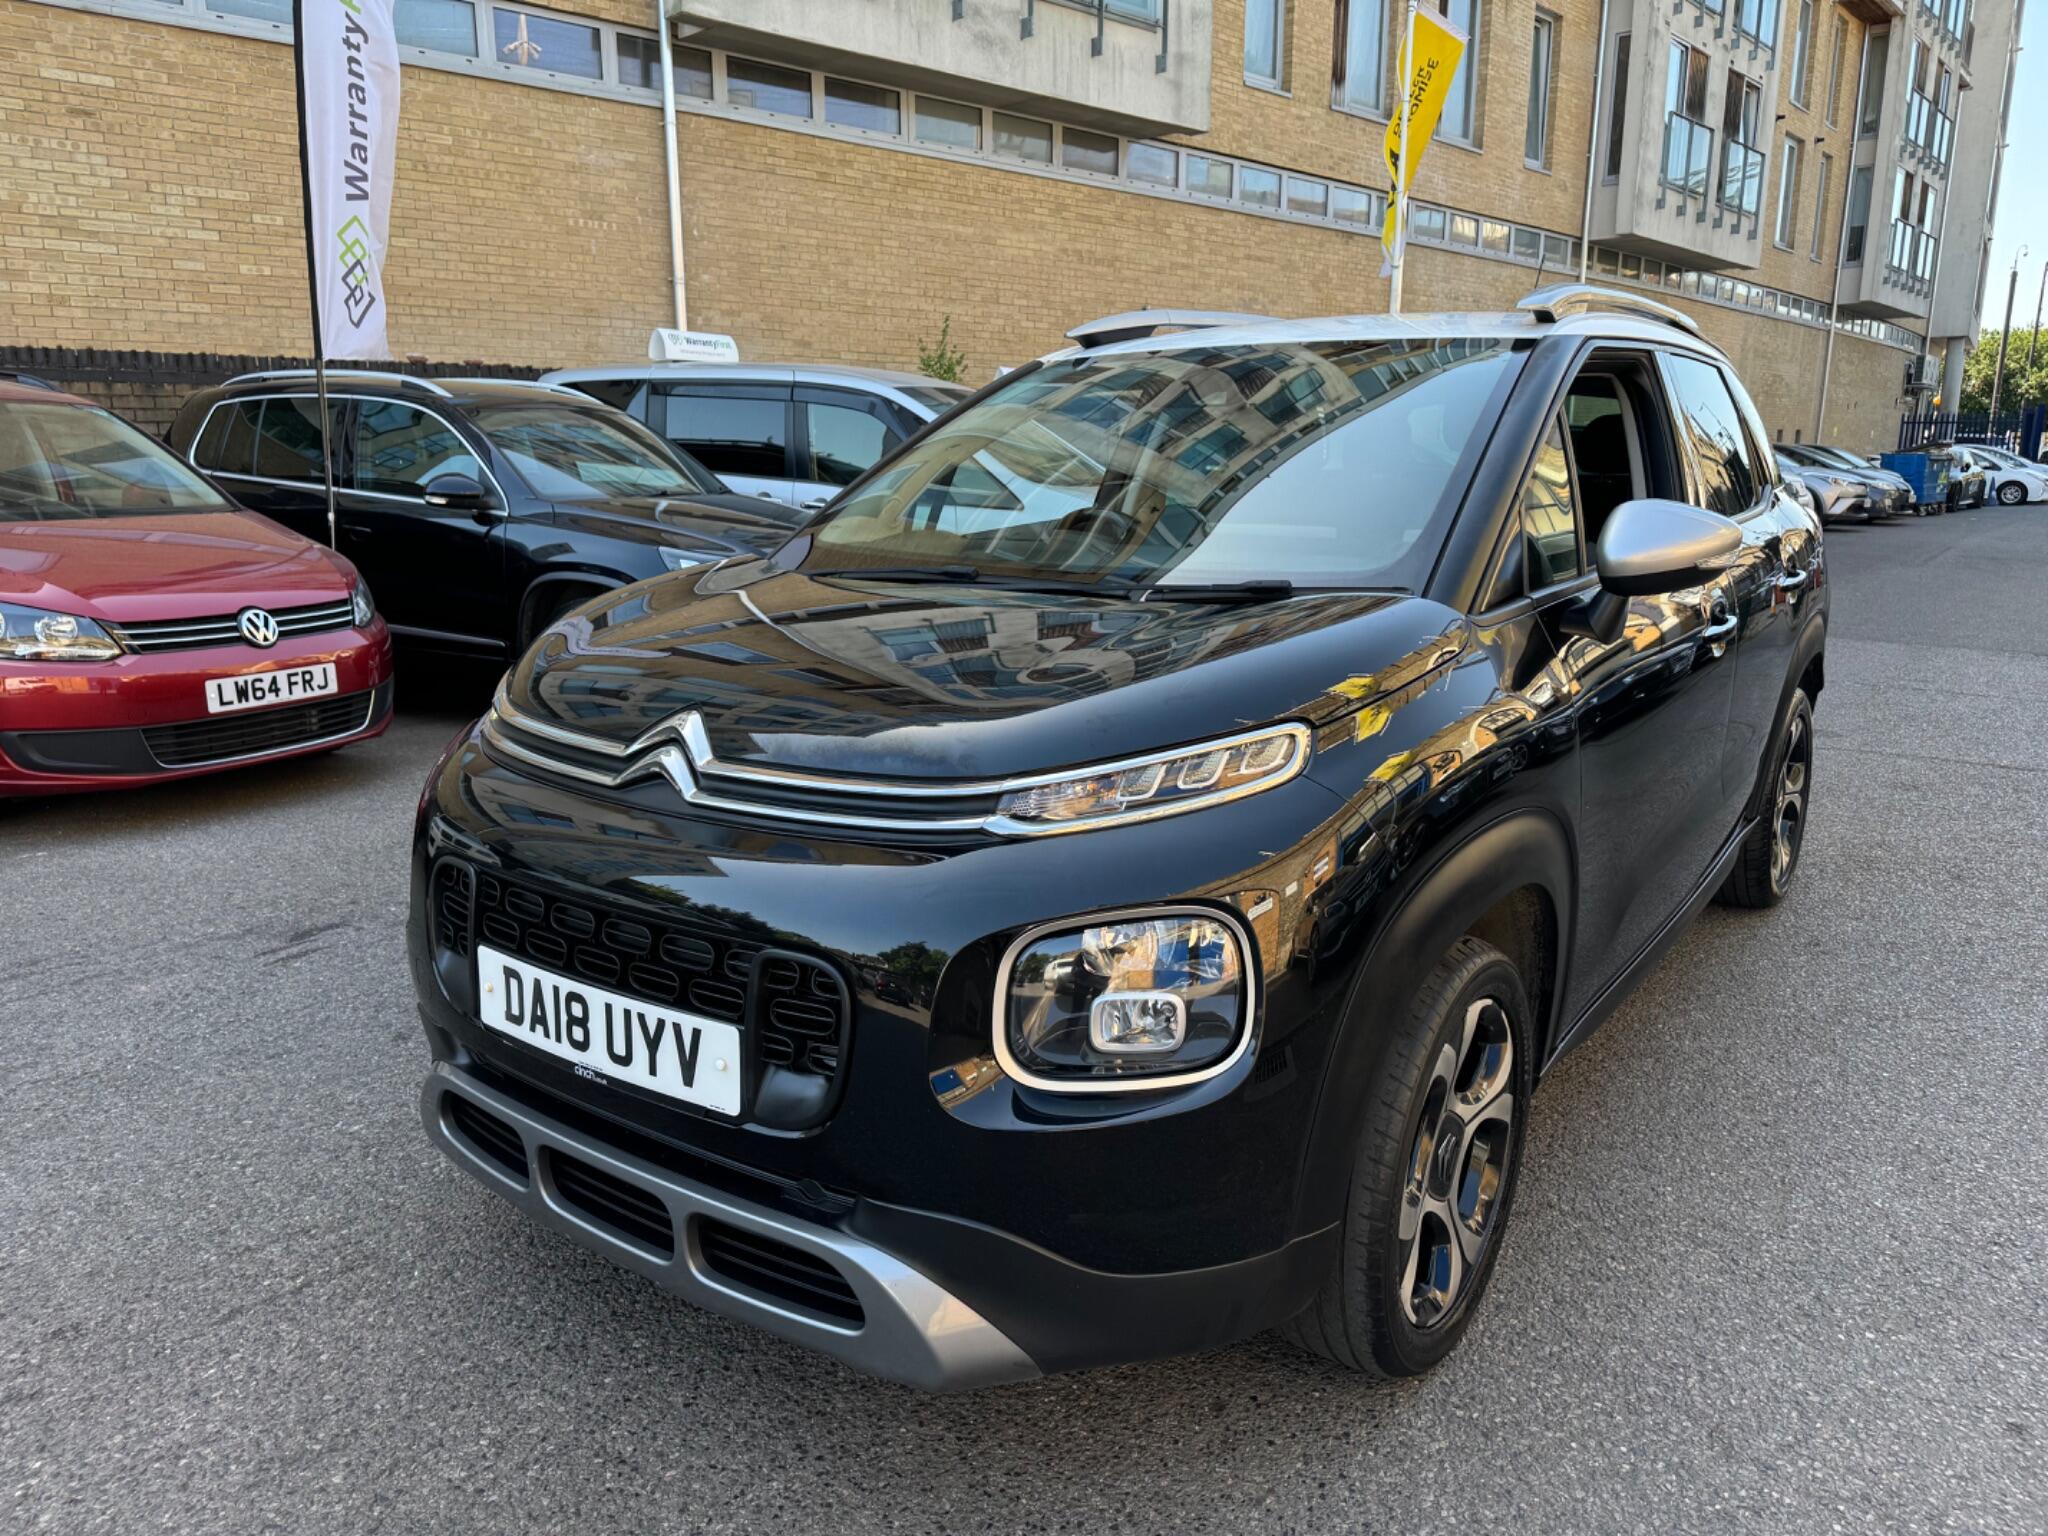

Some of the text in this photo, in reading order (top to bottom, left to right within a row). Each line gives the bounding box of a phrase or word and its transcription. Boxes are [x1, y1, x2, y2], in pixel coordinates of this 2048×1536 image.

[217, 667, 329, 706] LW64 FRJ
[503, 964, 702, 1088] DA18 UYV
